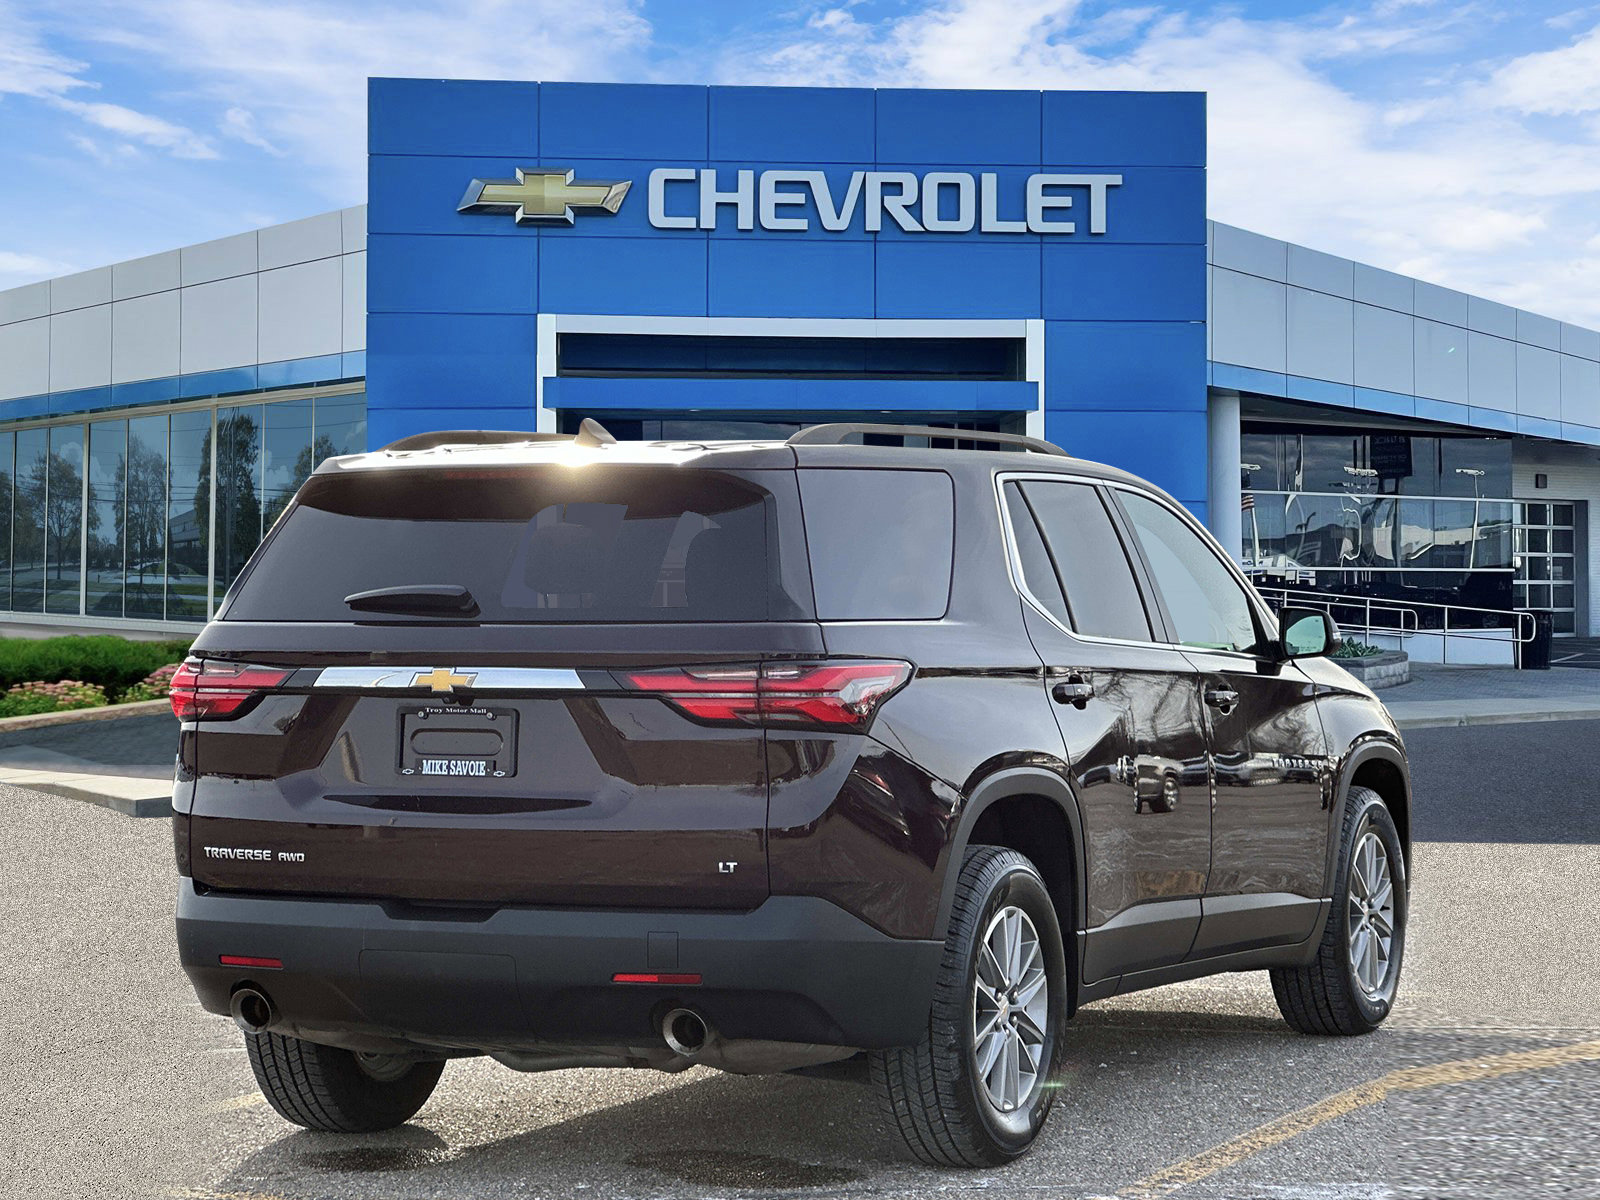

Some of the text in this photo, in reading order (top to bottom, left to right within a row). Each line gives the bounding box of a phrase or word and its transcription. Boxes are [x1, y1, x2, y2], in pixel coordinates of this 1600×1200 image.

[648, 168, 1123, 234] CHEVROLET
[422, 760, 486, 776] MIKE SAVOIE
[203, 846, 305, 862] TRAVERSE AWD
[718, 861, 738, 873] LT
